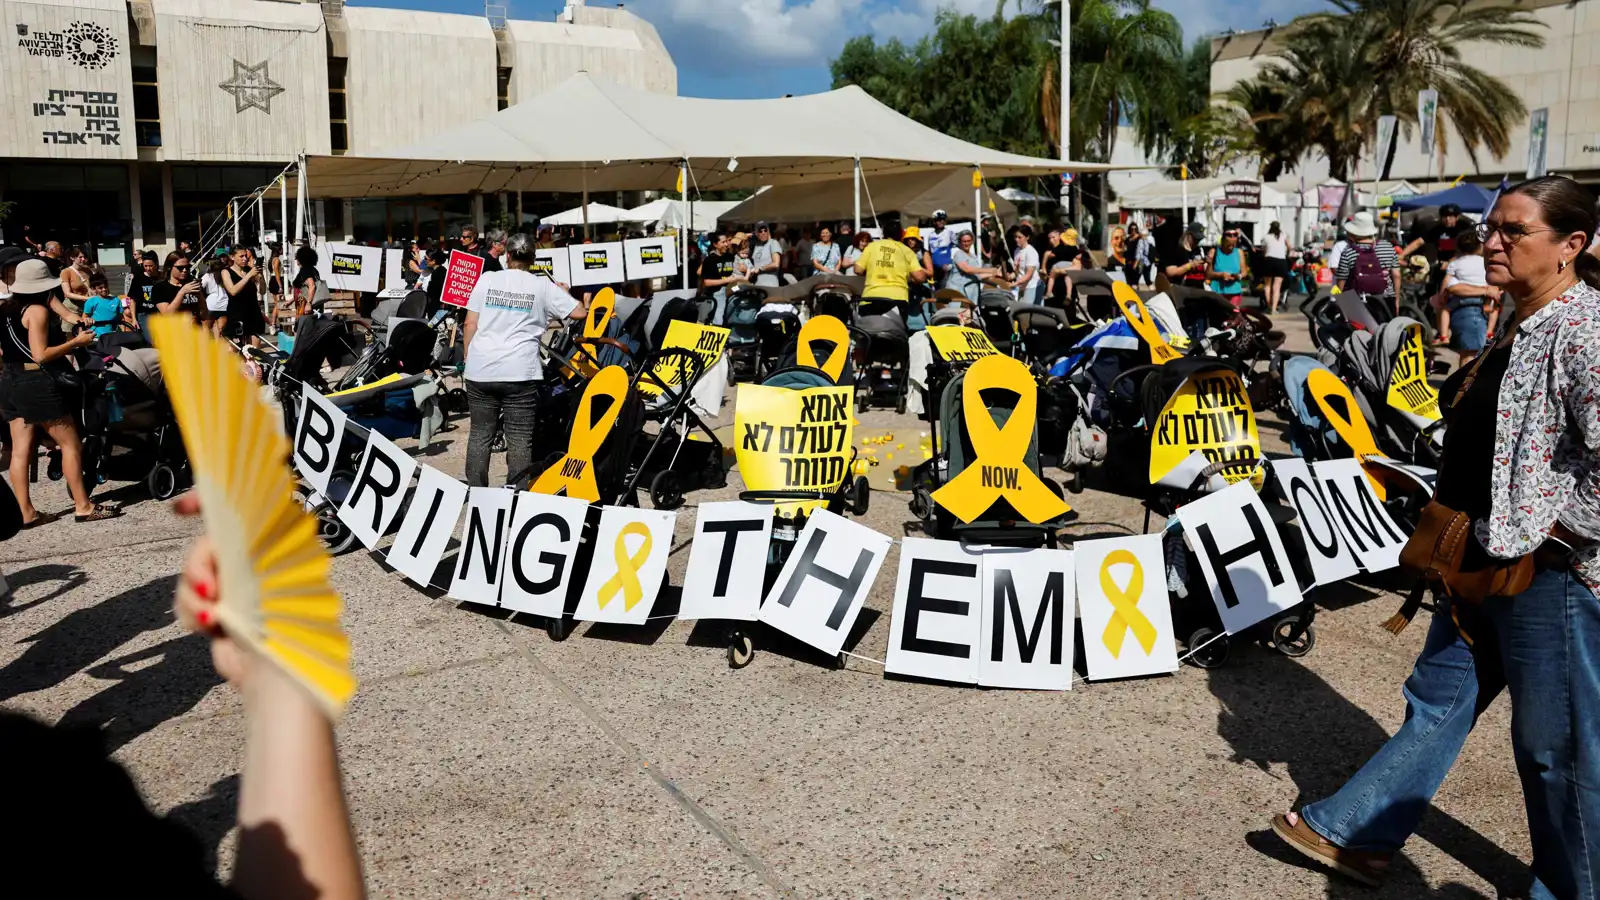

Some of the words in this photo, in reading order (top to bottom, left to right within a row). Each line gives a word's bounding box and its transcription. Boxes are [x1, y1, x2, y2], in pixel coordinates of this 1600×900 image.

[18, 38, 40, 47] AVIV
[33, 32, 49, 40] TEL
[27, 48, 50, 57] YAFO
[48, 89, 118, 104] ספריית
[85, 118, 120, 132] בית
[43, 130, 120, 146] אריאלה
[696, 330, 725, 352] אמא
[961, 331, 993, 350] אמא
[1194, 376, 1246, 410] אמא
[801, 393, 848, 423] אמא
[742, 421, 774, 452] לא
[1158, 410, 1178, 446] לא
[1183, 406, 1248, 445] לעולם
[778, 422, 848, 454] לעולם
[560, 458, 587, 480] NOW.
[780, 456, 844, 486] תוותר
[982, 465, 1022, 490] NOW.
[297, 395, 570, 596] BRING
[702, 518, 1064, 666] THEM
[1195, 467, 1437, 609] HOM
